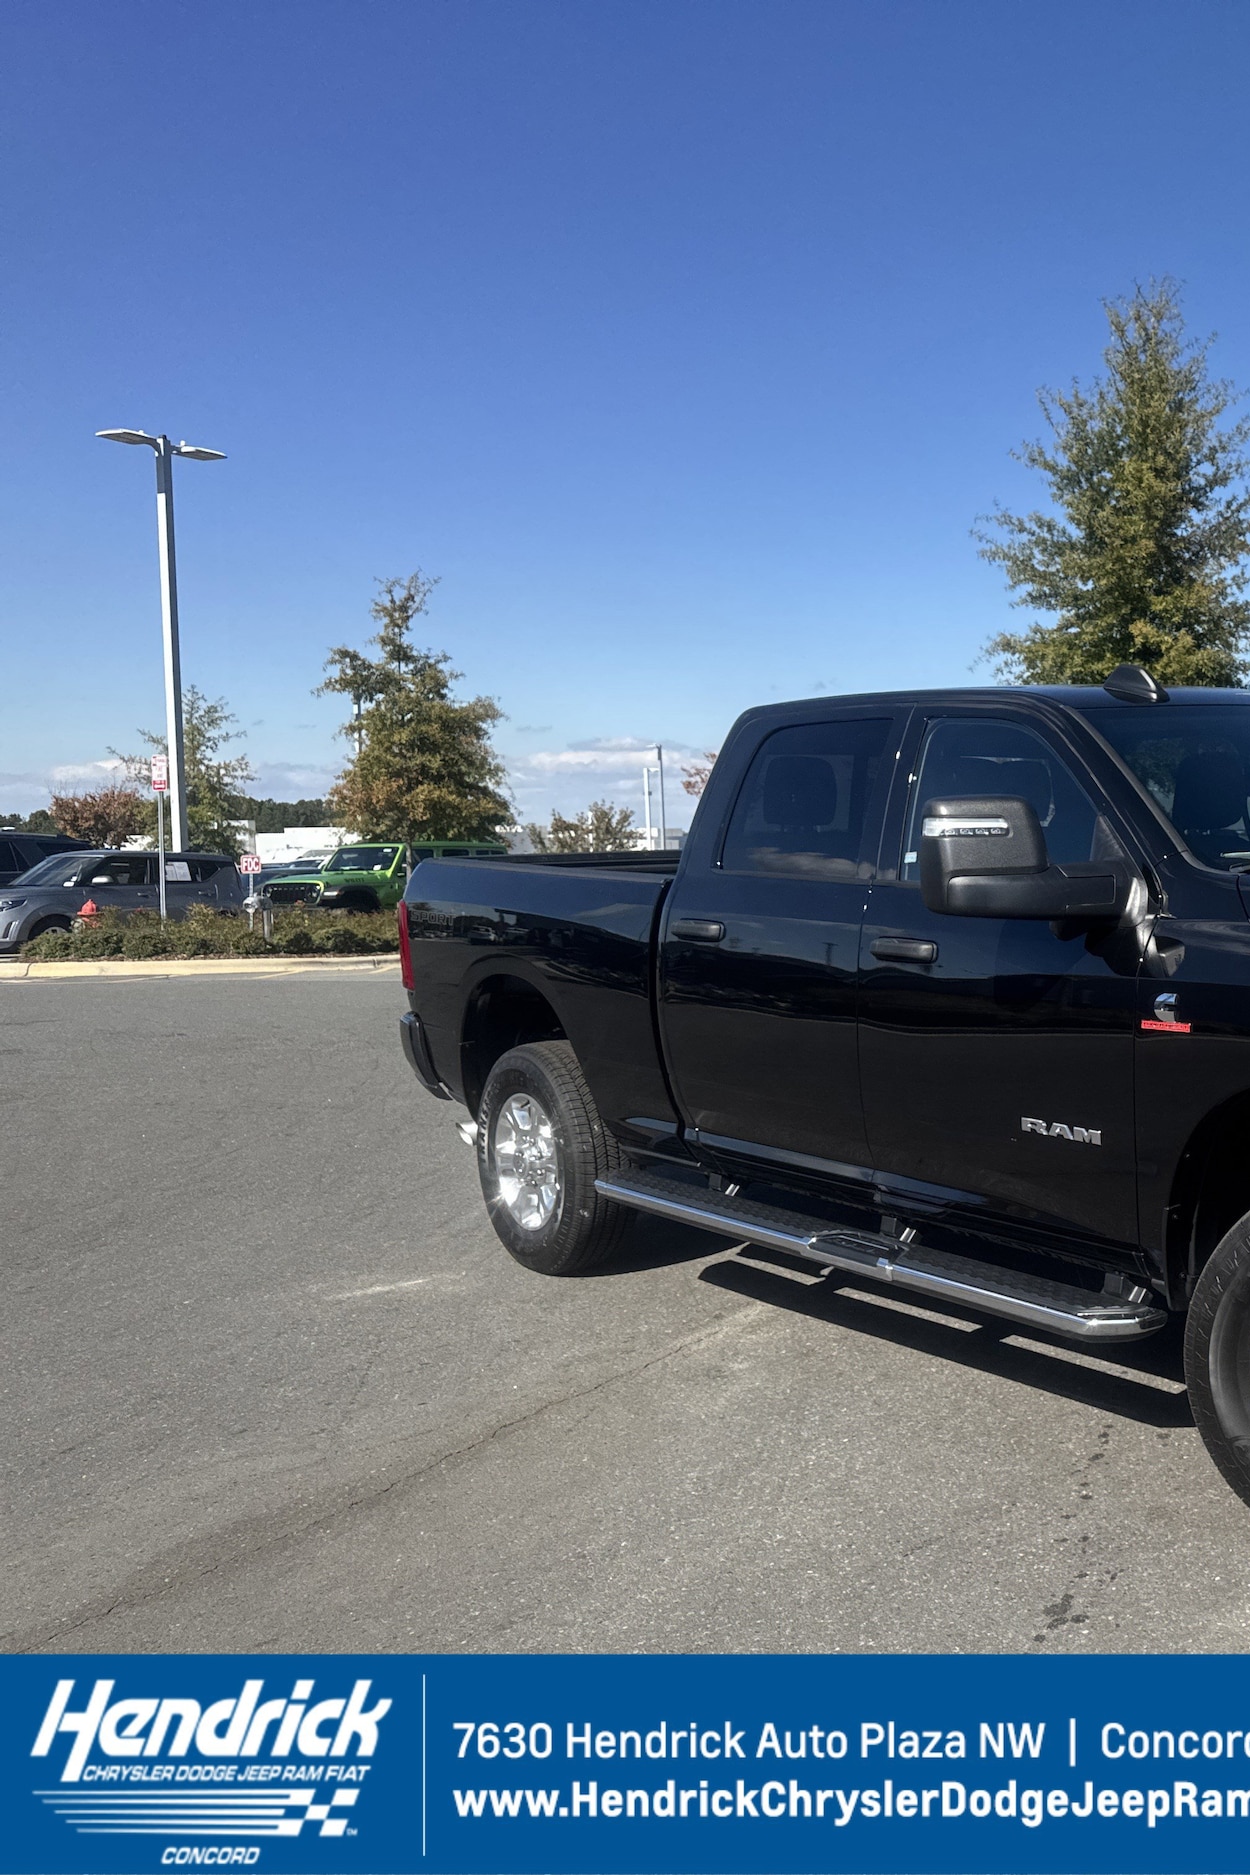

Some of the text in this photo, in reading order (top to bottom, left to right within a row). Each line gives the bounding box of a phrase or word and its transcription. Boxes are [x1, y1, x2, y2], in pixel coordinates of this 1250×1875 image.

[242, 857, 260, 872] FDC
[410, 910, 457, 926] SPORT
[1021, 1117, 1102, 1146] RAM
